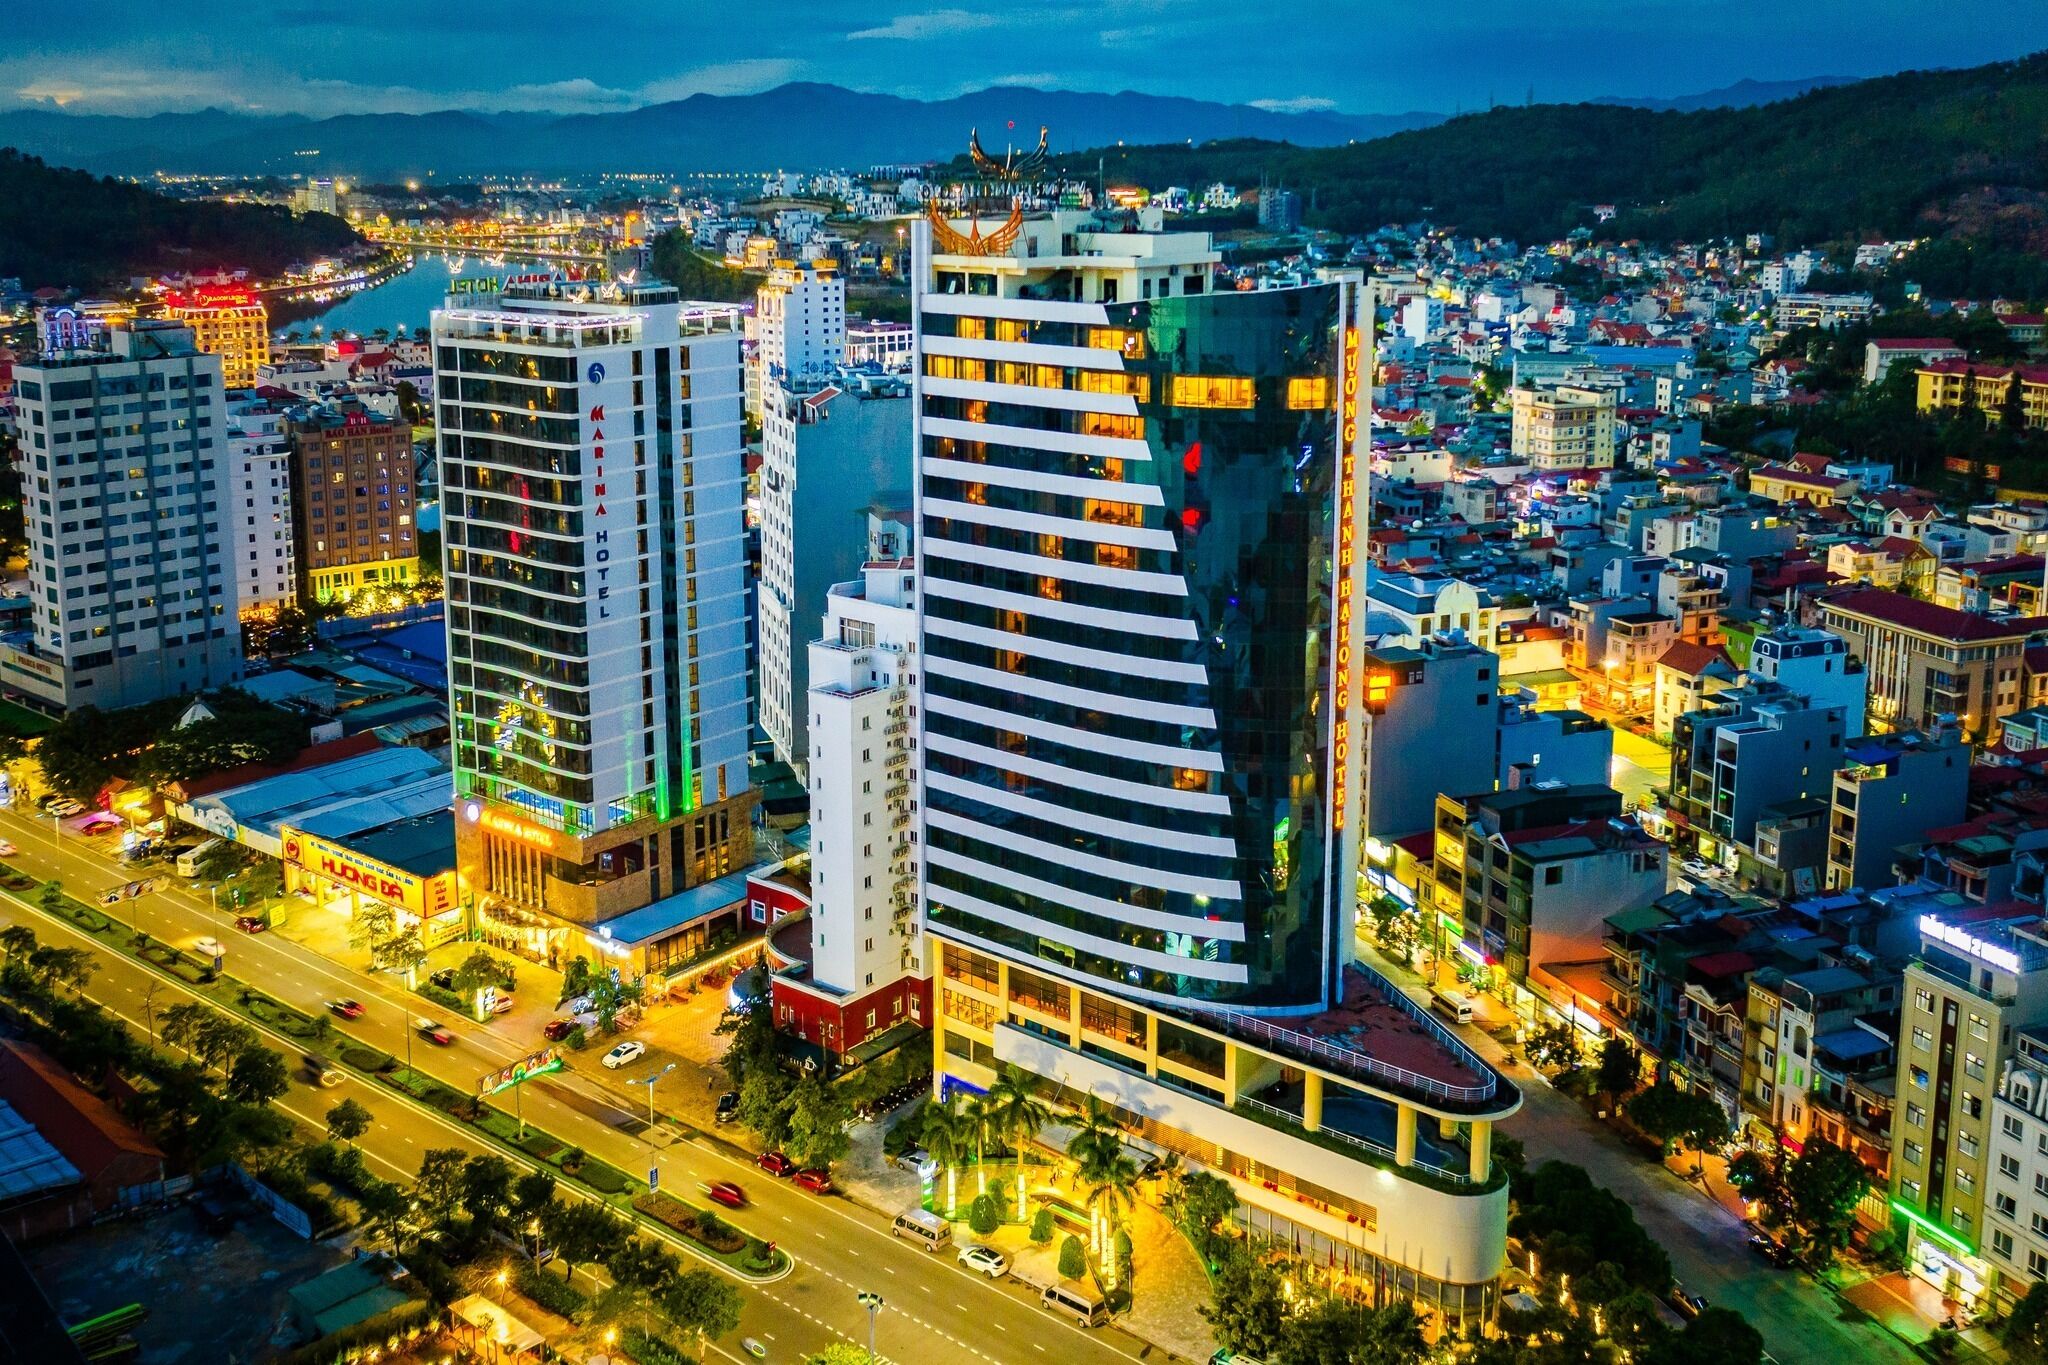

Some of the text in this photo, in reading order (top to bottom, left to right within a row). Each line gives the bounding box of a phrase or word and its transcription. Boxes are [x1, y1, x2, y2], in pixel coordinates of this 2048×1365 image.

[590, 404, 610, 619] MARINA HOTEL
[1340, 455, 1355, 566] THANH
[1337, 580, 1352, 708] HALONG
[1334, 720, 1348, 828] HOTEL
